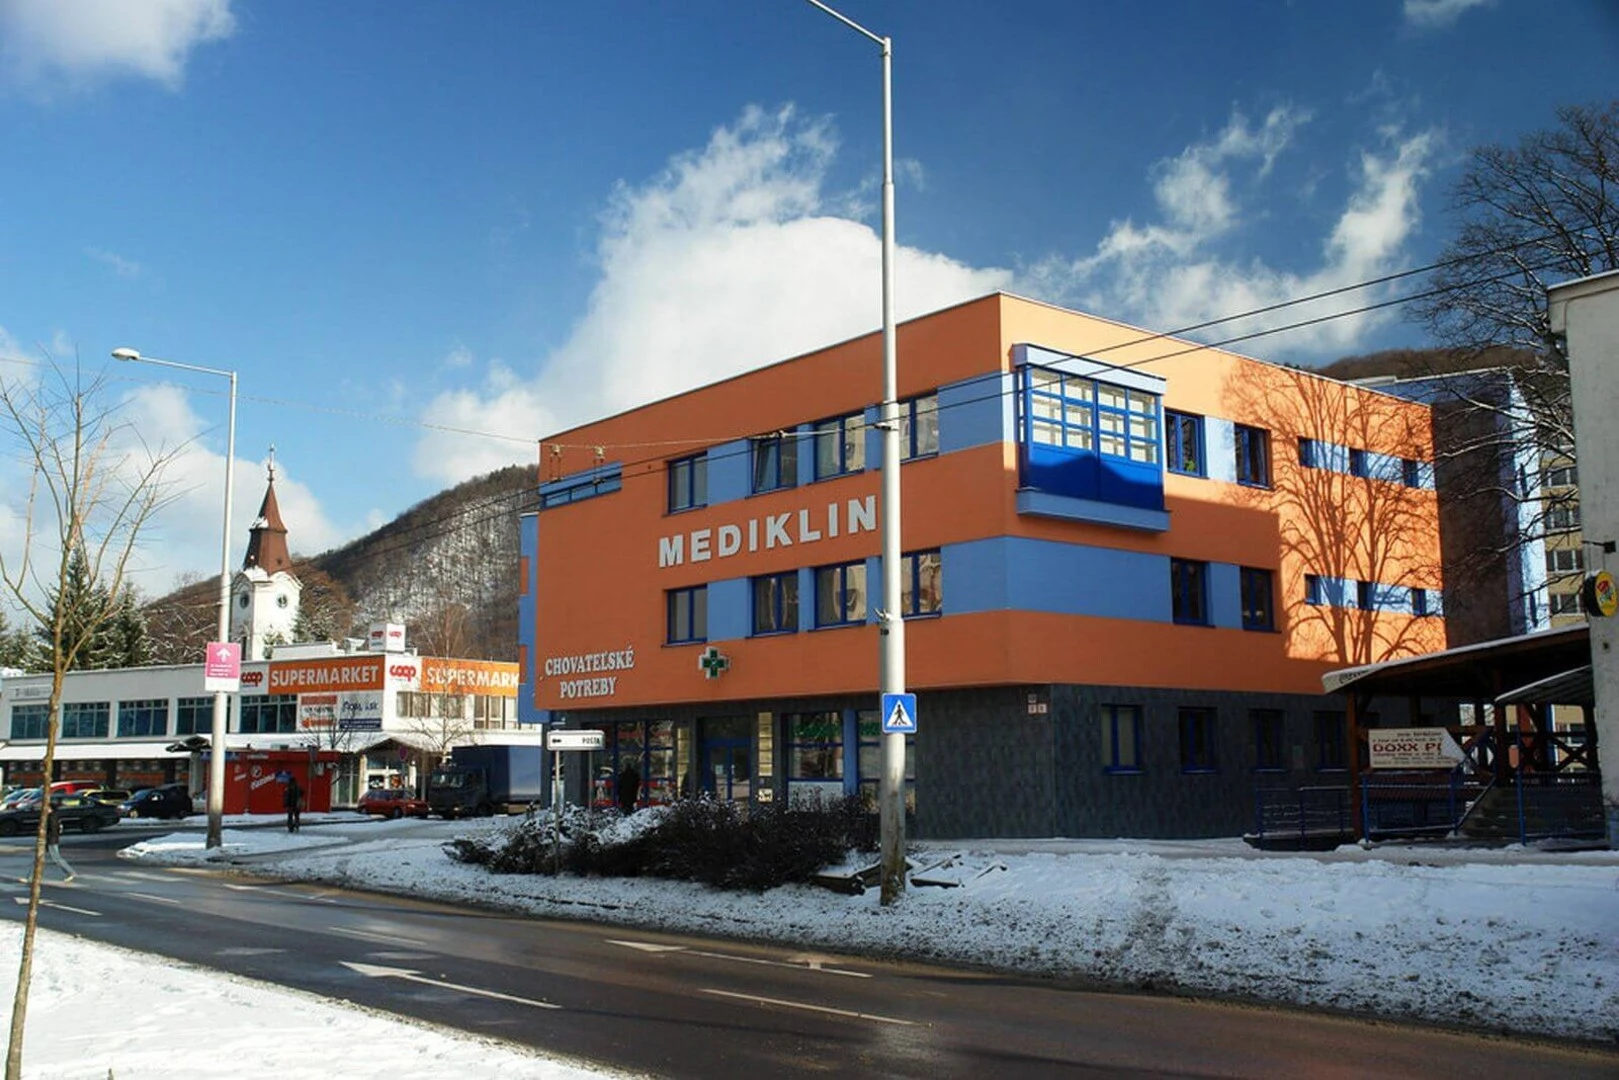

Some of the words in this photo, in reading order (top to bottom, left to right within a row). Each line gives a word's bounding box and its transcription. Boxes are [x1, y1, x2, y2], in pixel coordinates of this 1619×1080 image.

[658, 495, 876, 568] MEDIKLIN
[241, 671, 263, 687] coop
[271, 665, 379, 687] SUPERMARKET
[389, 665, 417, 682] coop
[560, 676, 617, 699] POTREBY
[1372, 742, 1419, 753] DOXX
